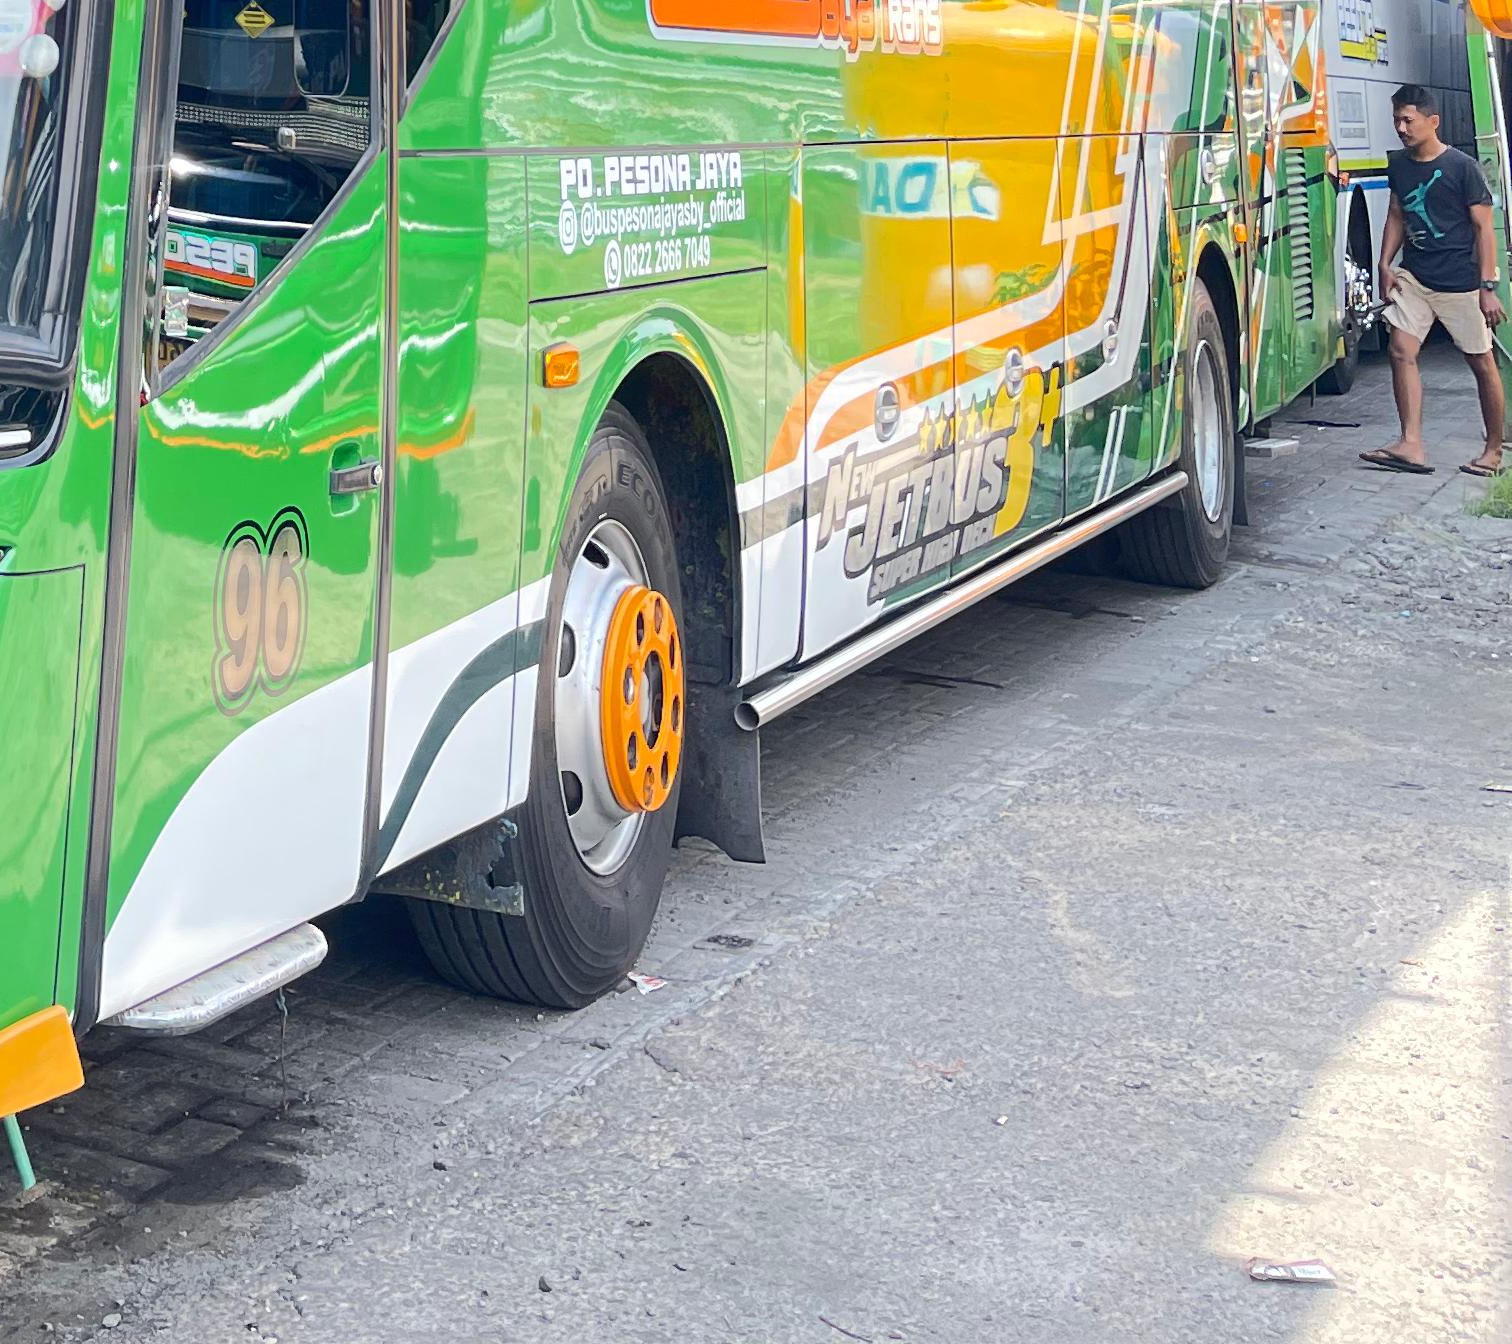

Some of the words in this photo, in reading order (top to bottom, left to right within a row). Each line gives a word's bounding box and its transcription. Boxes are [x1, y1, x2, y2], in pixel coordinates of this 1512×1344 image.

[695, 151, 742, 191] JAYA
[580, 190, 746, 247] @buspesonajayasby_official
[623, 242, 652, 278] 0822
[655, 238, 682, 273] 2666
[685, 235, 711, 269] 7049
[843, 435, 1009, 578] JETBUS
[212, 506, 310, 717] 96
